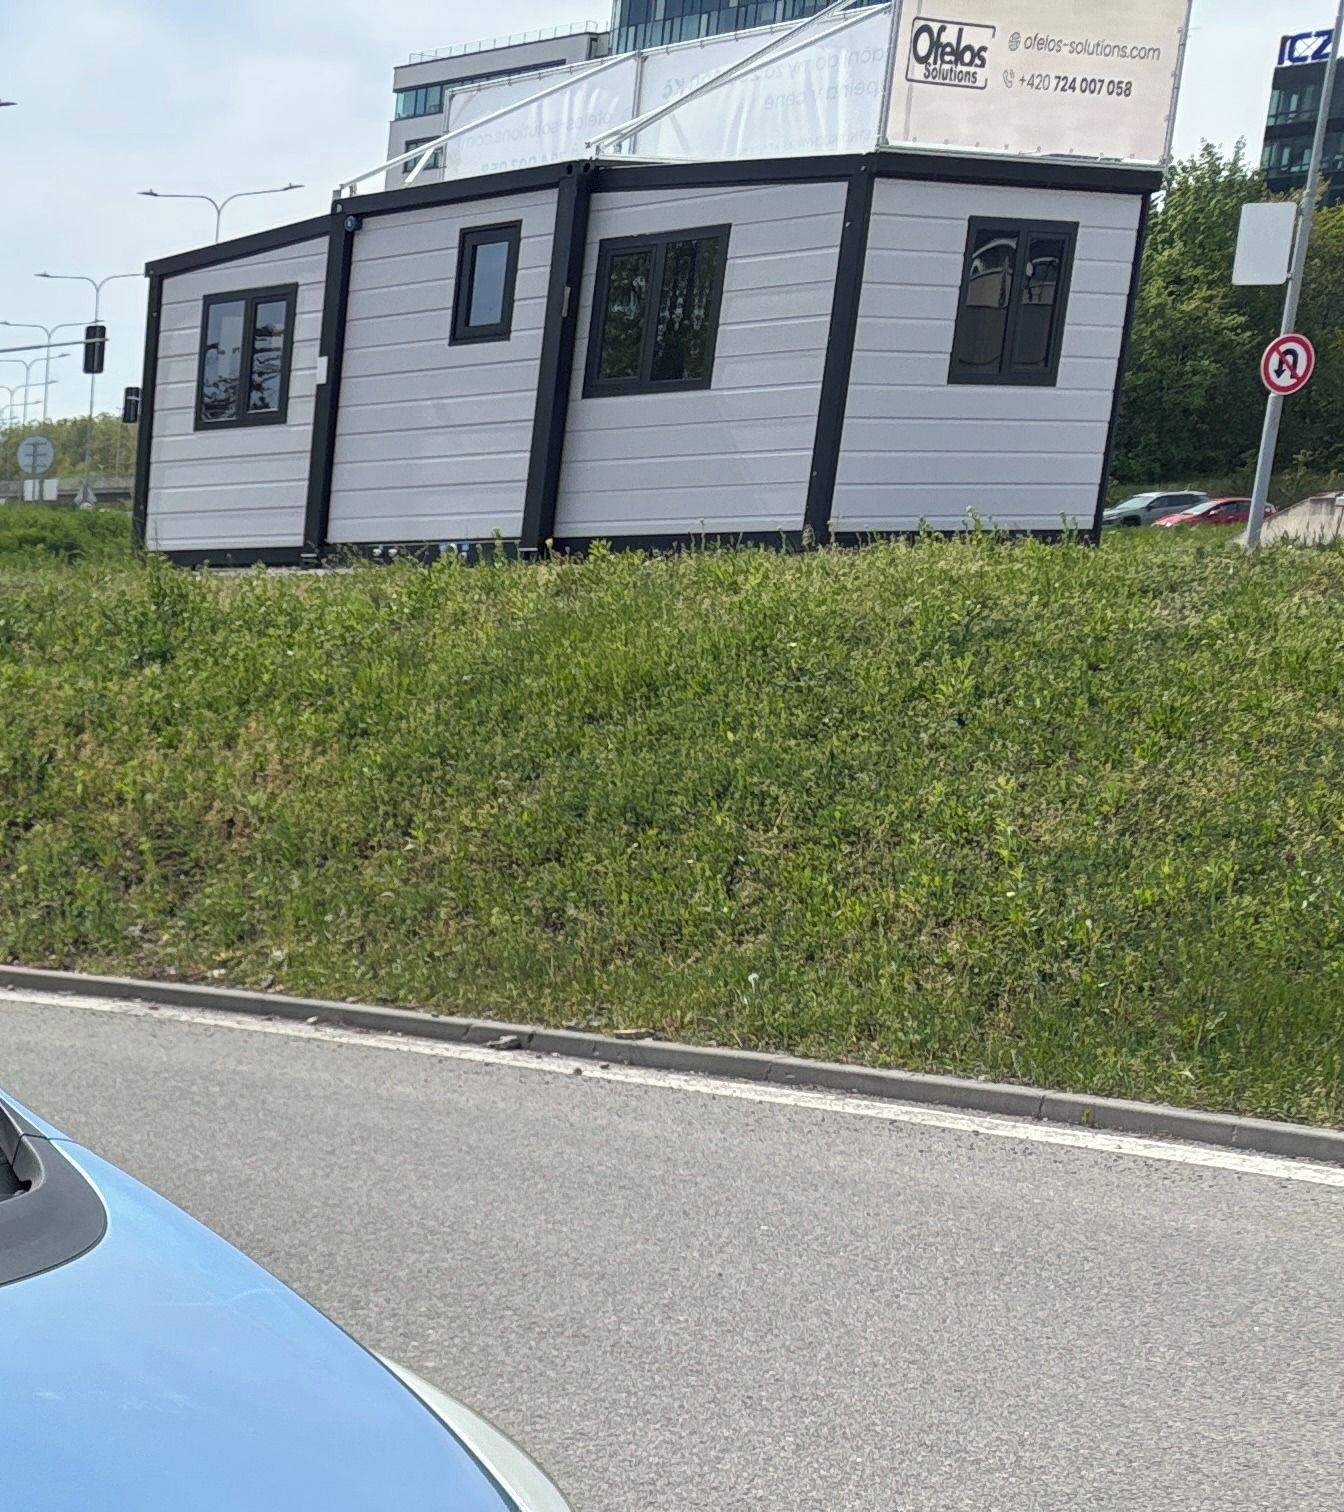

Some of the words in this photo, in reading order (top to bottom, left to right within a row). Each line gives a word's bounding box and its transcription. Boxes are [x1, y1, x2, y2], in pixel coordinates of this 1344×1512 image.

[912, 24, 988, 69] Ofelos
[1024, 33, 1160, 62] ofelos-solutions.com
[1277, 28, 1334, 66] ICZ
[923, 63, 978, 85] Solutions
[1018, 73, 1051, 91] +420
[1054, 75, 1077, 93] 724
[1080, 77, 1104, 96] 007
[1107, 80, 1133, 97] 058
